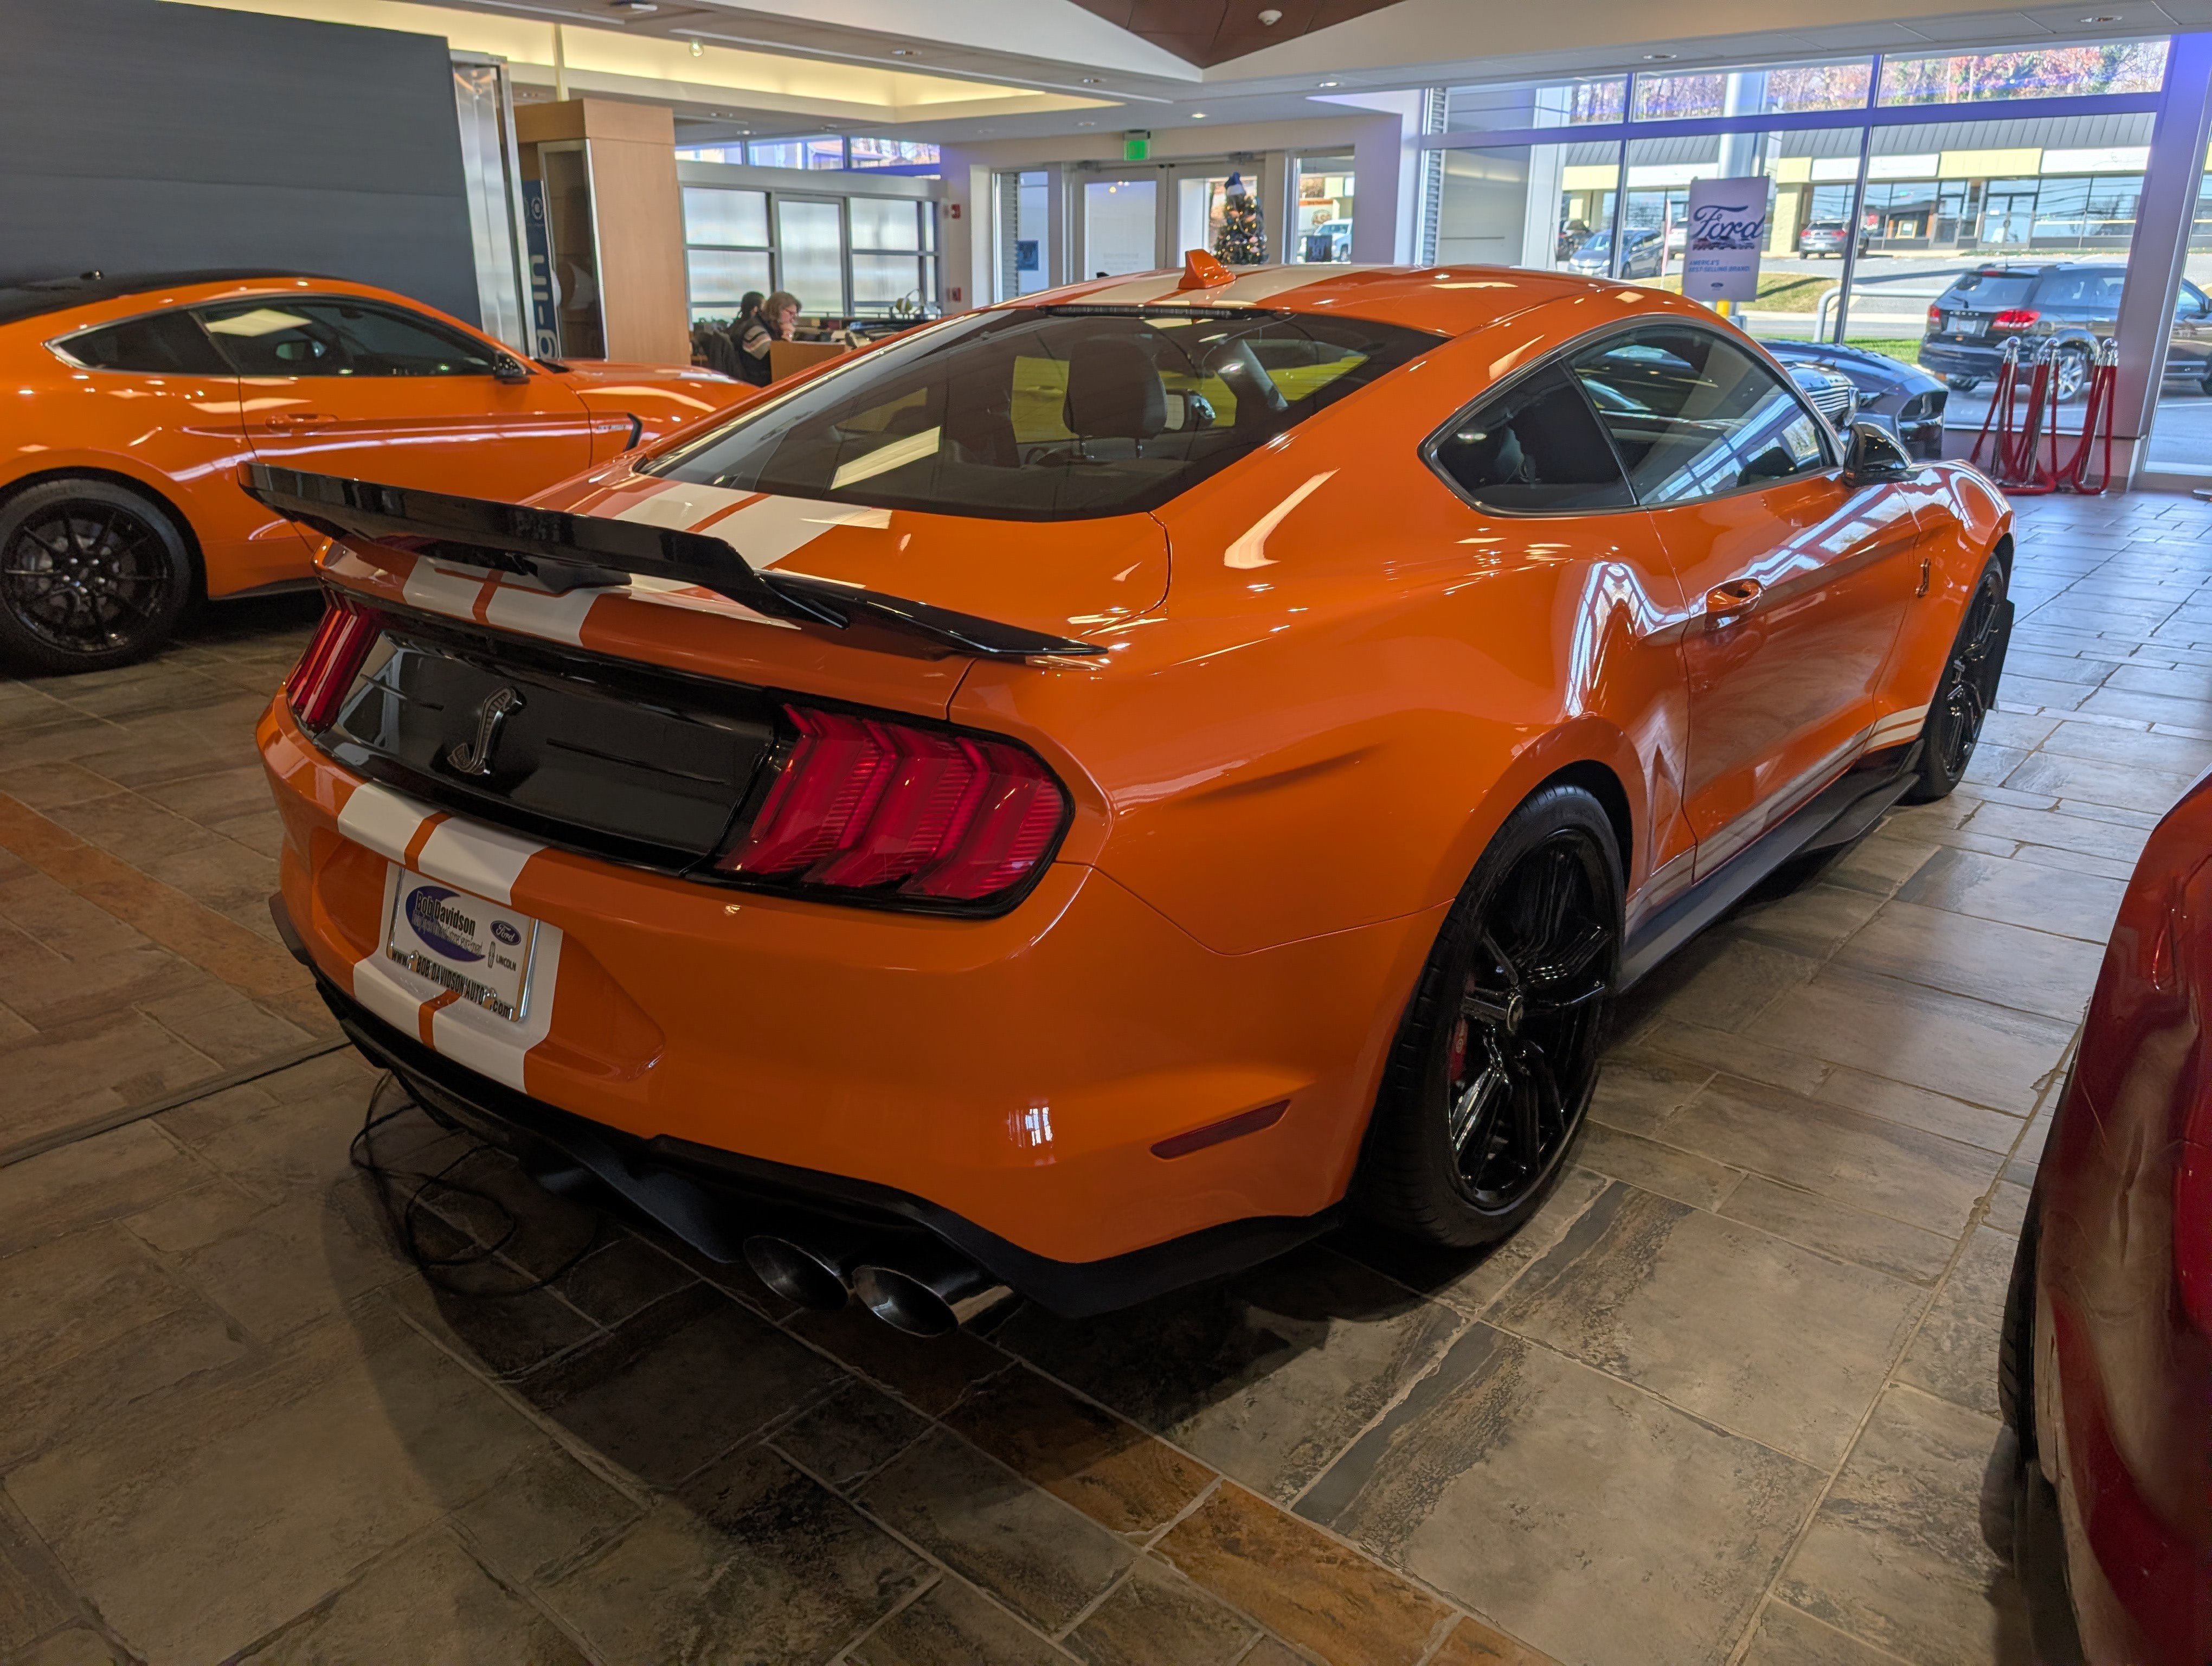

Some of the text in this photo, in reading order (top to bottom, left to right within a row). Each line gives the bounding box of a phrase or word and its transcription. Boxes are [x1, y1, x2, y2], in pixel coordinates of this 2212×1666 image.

[1692, 205, 1766, 240] Ford
[415, 891, 434, 918] Bob
[434, 900, 476, 937] Davidson
[496, 924, 516, 943] Ford
[496, 953, 517, 971] LINCOLN
